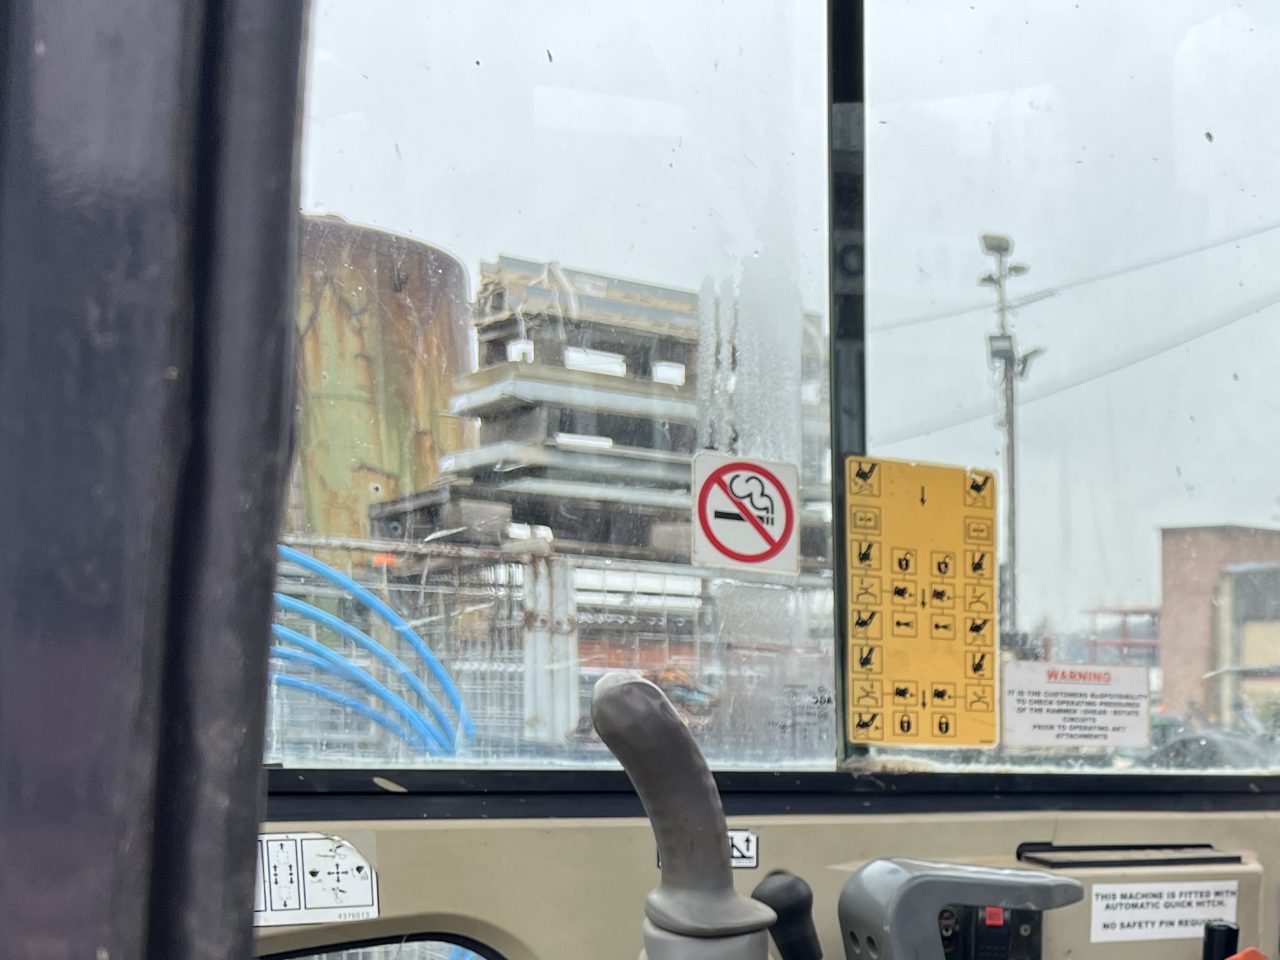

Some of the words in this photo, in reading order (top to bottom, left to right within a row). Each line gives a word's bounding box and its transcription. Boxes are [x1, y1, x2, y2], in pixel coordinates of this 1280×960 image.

[1047, 670, 1111, 683] WARNING
[1095, 892, 1117, 900] THIS
[1120, 891, 1163, 900] MACHINE
[1166, 891, 1175, 899] IS
[1178, 890, 1211, 899] FITTED
[1213, 889, 1237, 898] WITH
[1105, 902, 1161, 911] AUTOMATIC
[1163, 901, 1192, 909] QUICK
[1102, 922, 1116, 930] NO
[1119, 920, 1156, 930] SAFETY
[1159, 920, 1175, 928] PIN
